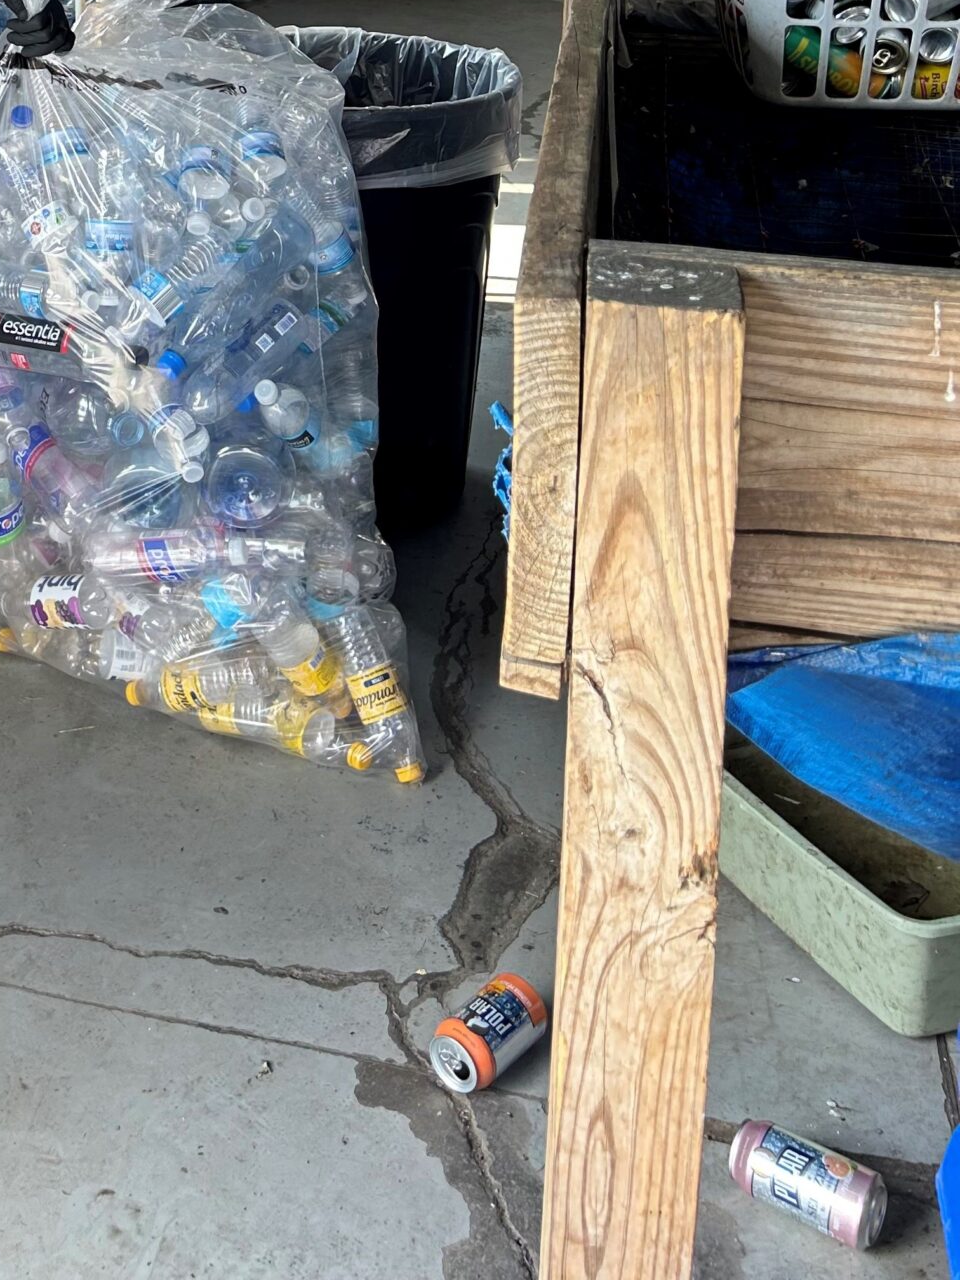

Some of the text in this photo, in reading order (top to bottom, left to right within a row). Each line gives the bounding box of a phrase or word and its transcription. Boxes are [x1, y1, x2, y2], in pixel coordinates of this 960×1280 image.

[931, 72, 941, 98] Birch
[2, 320, 61, 341] essentia
[37, 574, 85, 593] hint
[469, 997, 513, 1035] POLAR
[774, 1148, 810, 1204] POAR
